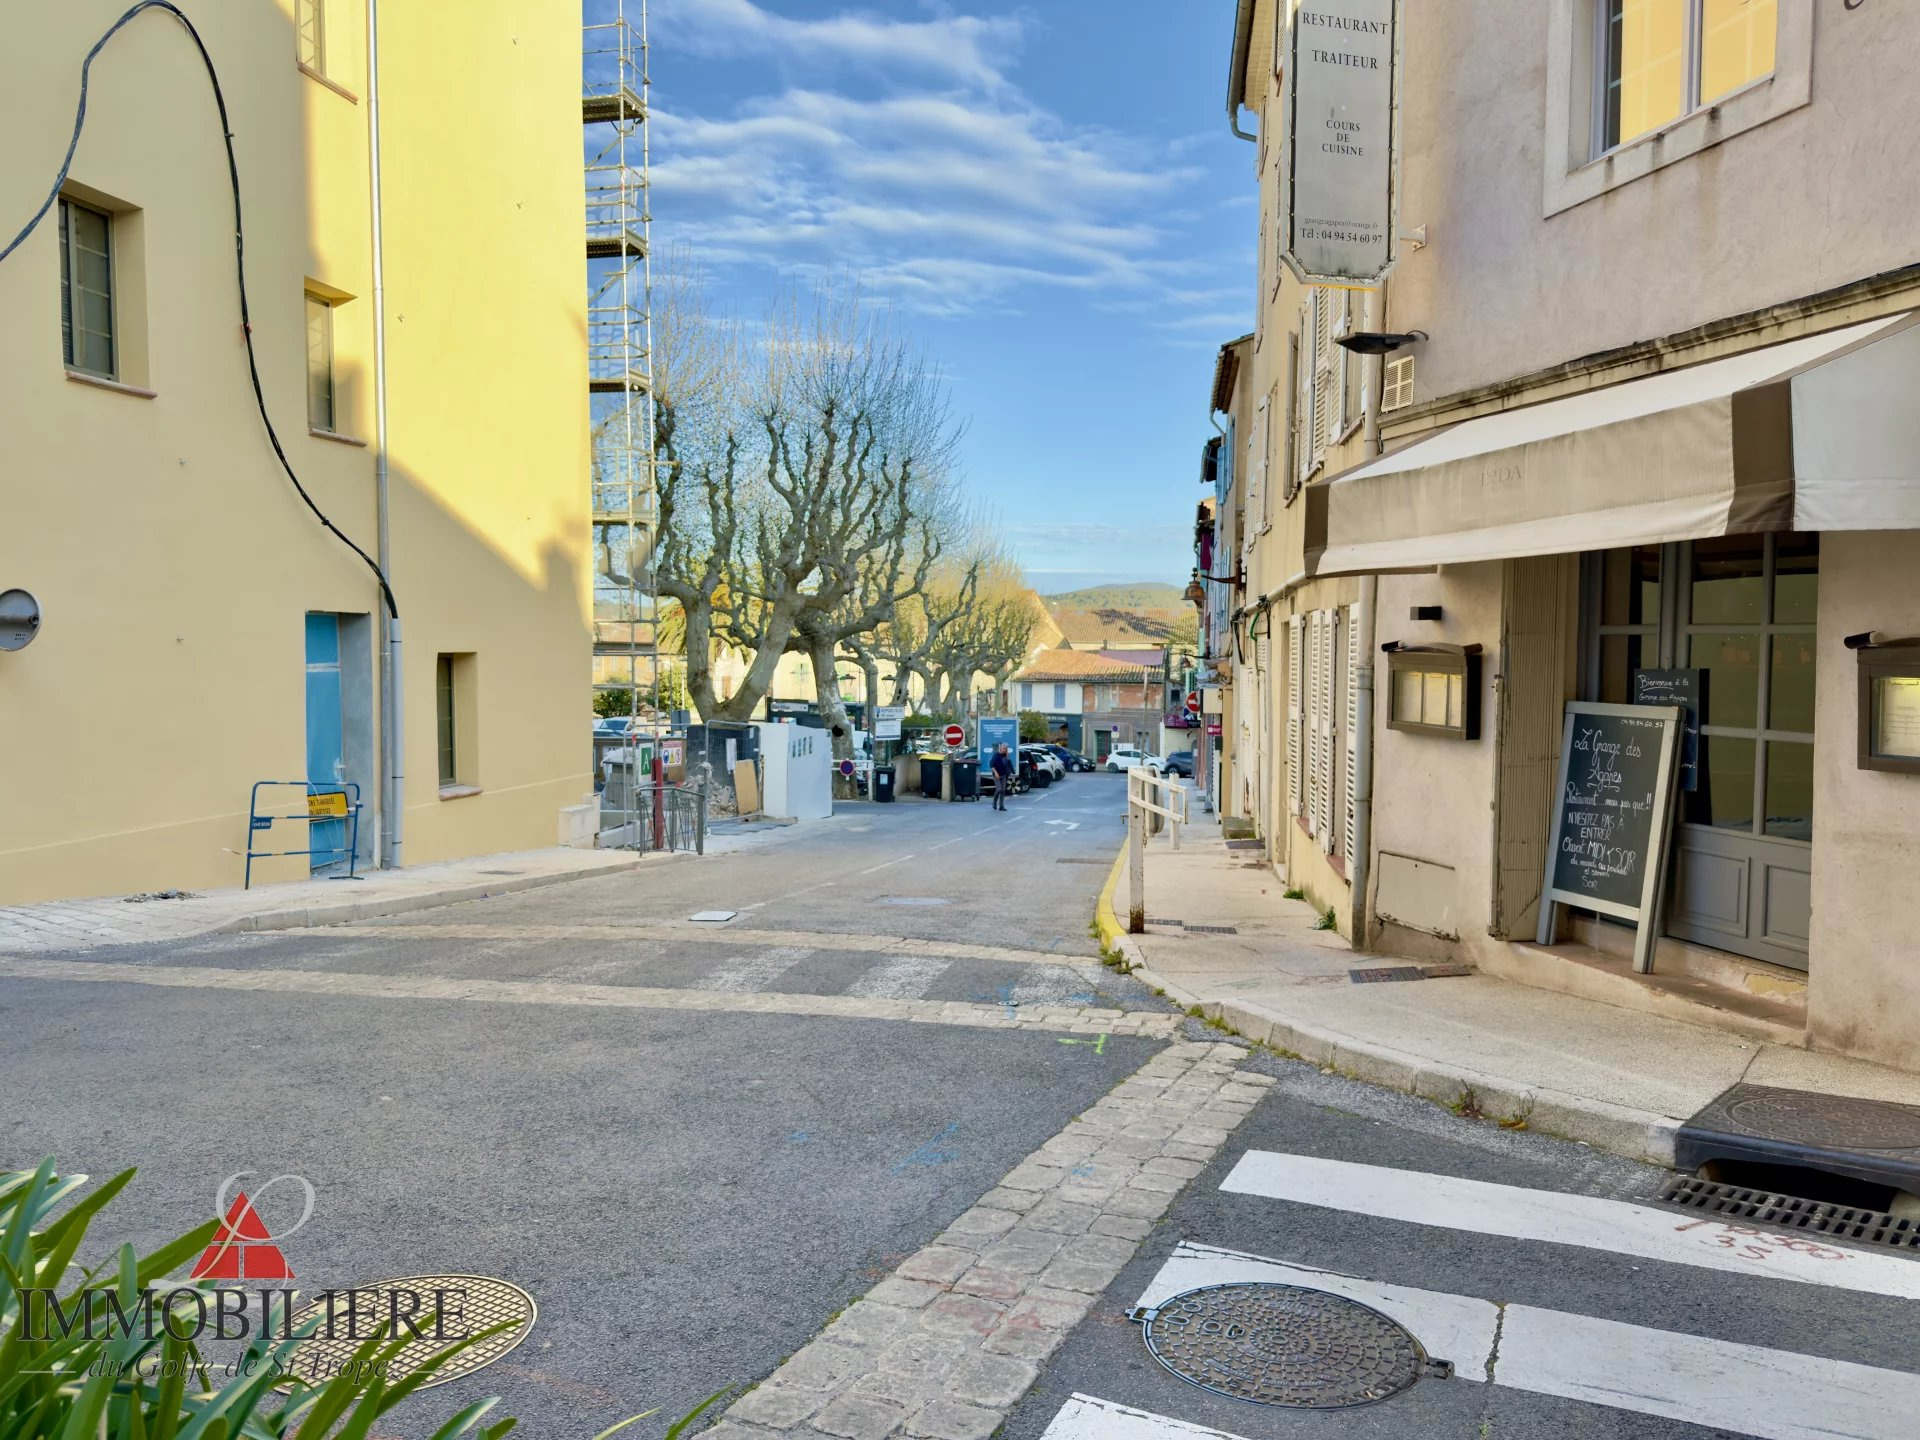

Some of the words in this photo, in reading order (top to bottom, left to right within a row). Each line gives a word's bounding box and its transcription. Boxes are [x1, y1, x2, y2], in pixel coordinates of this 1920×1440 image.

[1302, 12, 1388, 34] RESTAURANT
[1311, 49, 1378, 69] TRAITEUR
[1326, 119, 1360, 131] COURS
[1336, 132, 1350, 142] DE
[1321, 143, 1363, 156] CUISINE
[1300, 228, 1314, 239] Tél
[1321, 230, 1332, 240] 04
[1334, 231, 1345, 241] 94
[1346, 232, 1357, 243] 54
[1360, 233, 1370, 244] 60
[1372, 234, 1383, 244] 97
[1626, 736, 1642, 758] des
[1580, 827, 1612, 841] ENTRER
